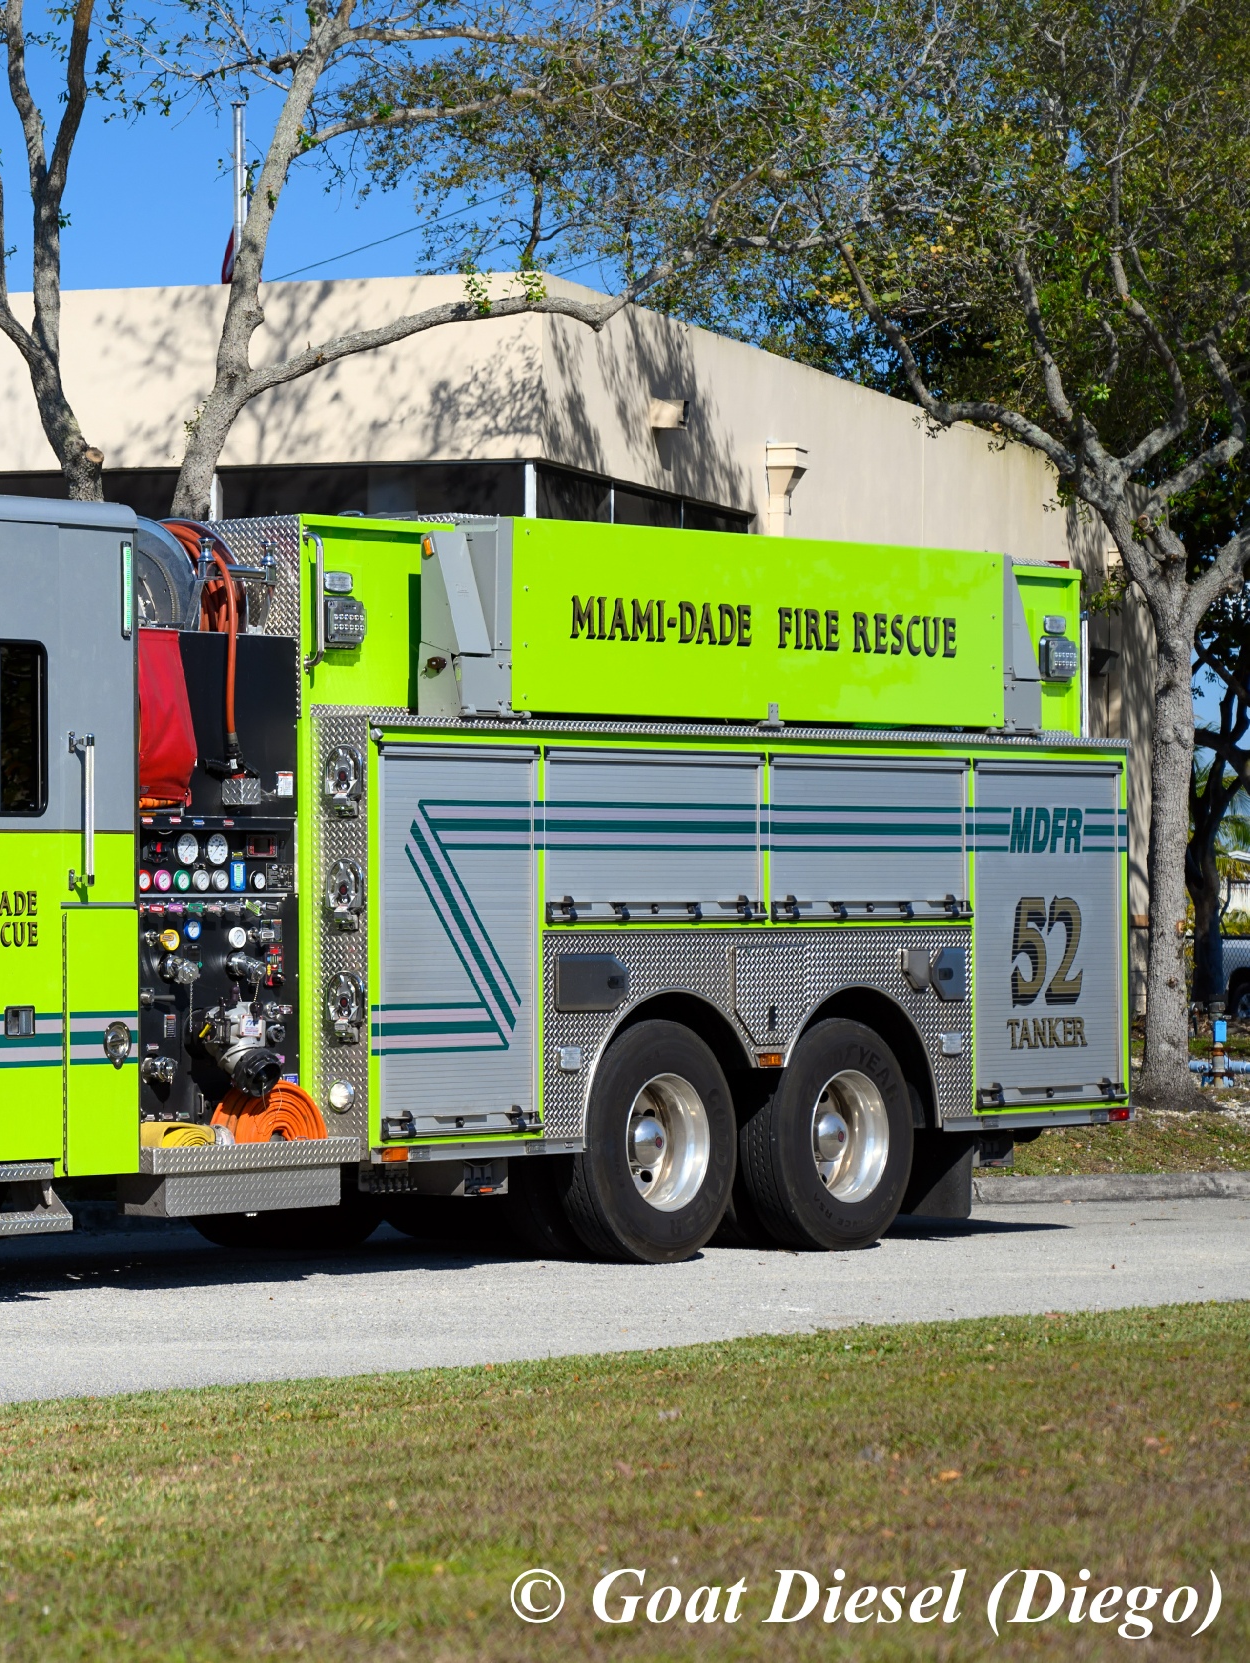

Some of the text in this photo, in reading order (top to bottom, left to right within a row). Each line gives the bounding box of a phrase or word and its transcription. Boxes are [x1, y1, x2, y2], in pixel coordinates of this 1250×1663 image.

[570, 595, 958, 659] MIAMI-DADE FIRE RESCUE
[1009, 807, 1083, 854] MDFR
[1011, 895, 1084, 1009] 52
[1006, 1017, 1088, 1051] TANKER
